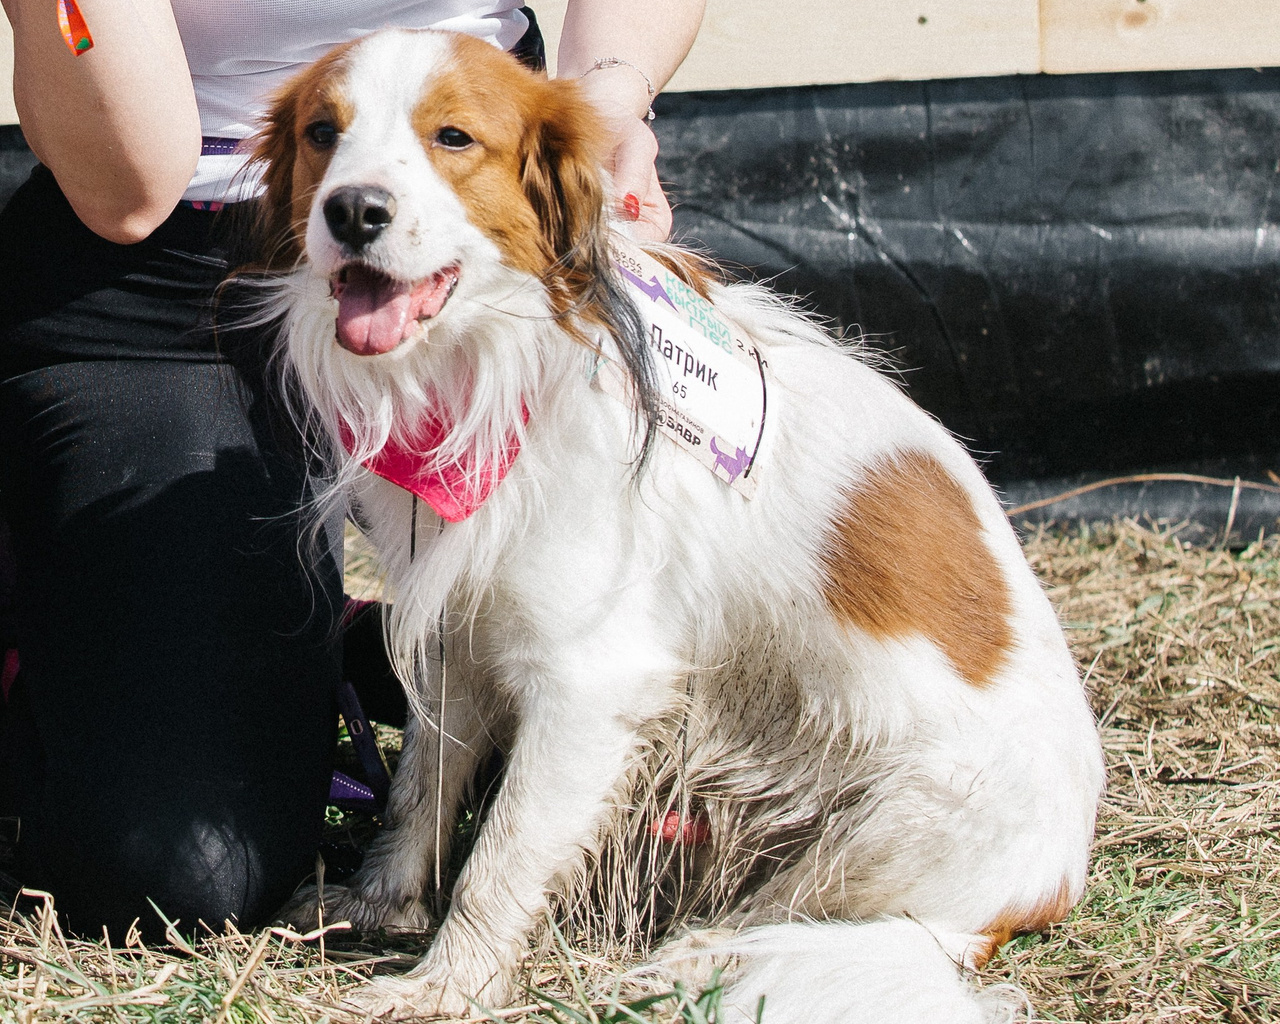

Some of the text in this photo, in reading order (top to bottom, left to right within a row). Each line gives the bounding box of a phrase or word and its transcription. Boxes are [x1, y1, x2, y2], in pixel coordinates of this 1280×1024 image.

[736, 338, 745, 352] 2
[651, 323, 719, 391] Патрик
[672, 381, 688, 399] 65
